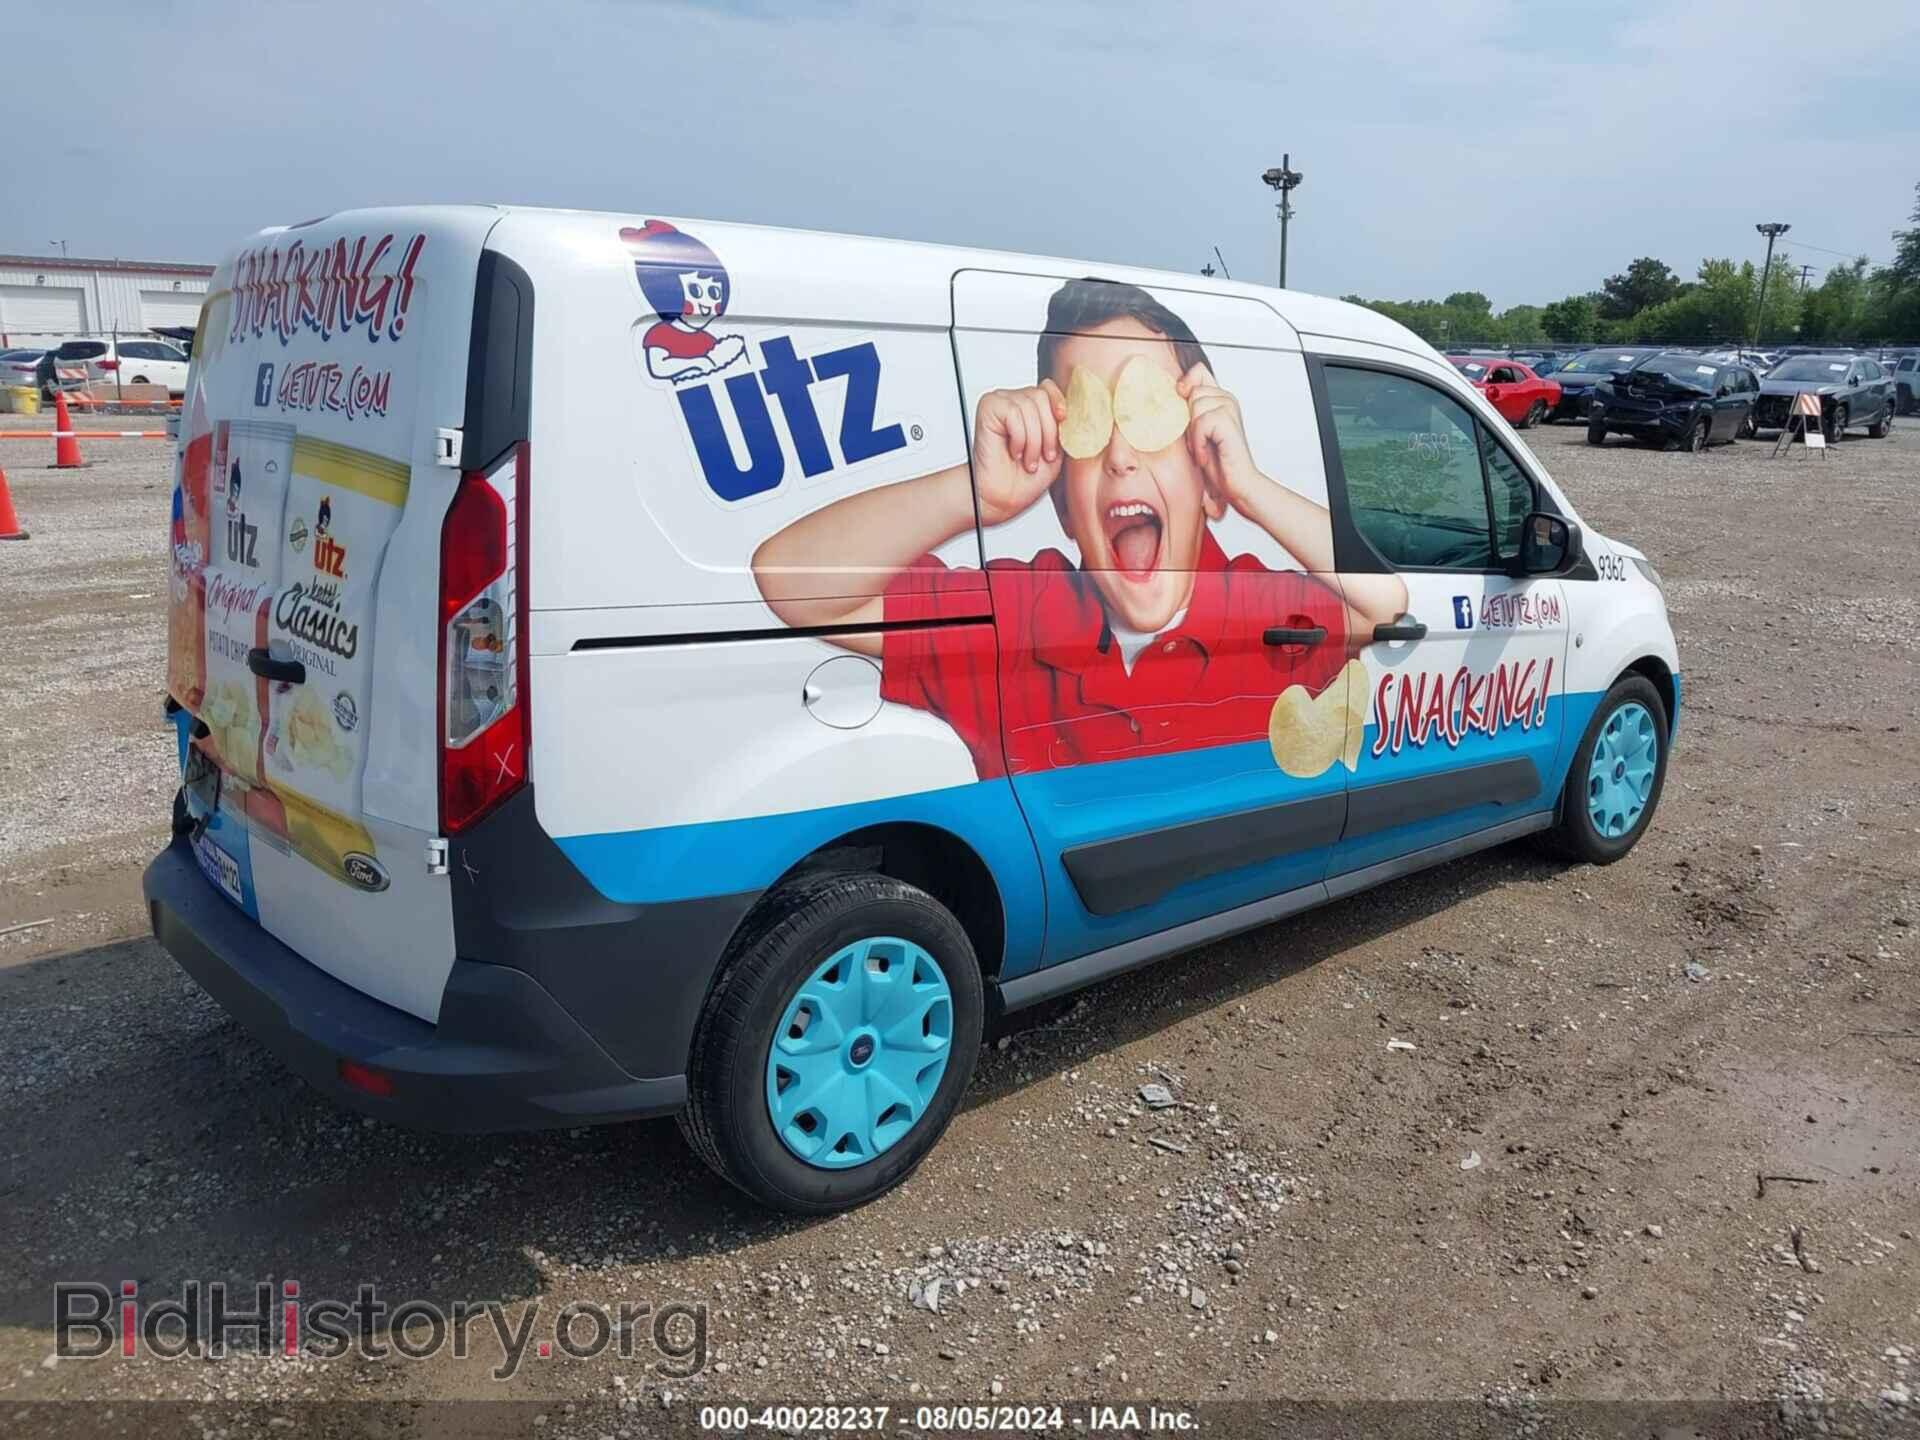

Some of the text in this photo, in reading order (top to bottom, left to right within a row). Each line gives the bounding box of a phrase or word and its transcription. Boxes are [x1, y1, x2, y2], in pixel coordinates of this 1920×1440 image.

[230, 234, 426, 346] SNACKING!
[1599, 555, 1627, 582] 9362
[275, 582, 358, 660] Classics
[1373, 656, 1554, 760] SNACKING!
[349, 859, 375, 884] Ford
